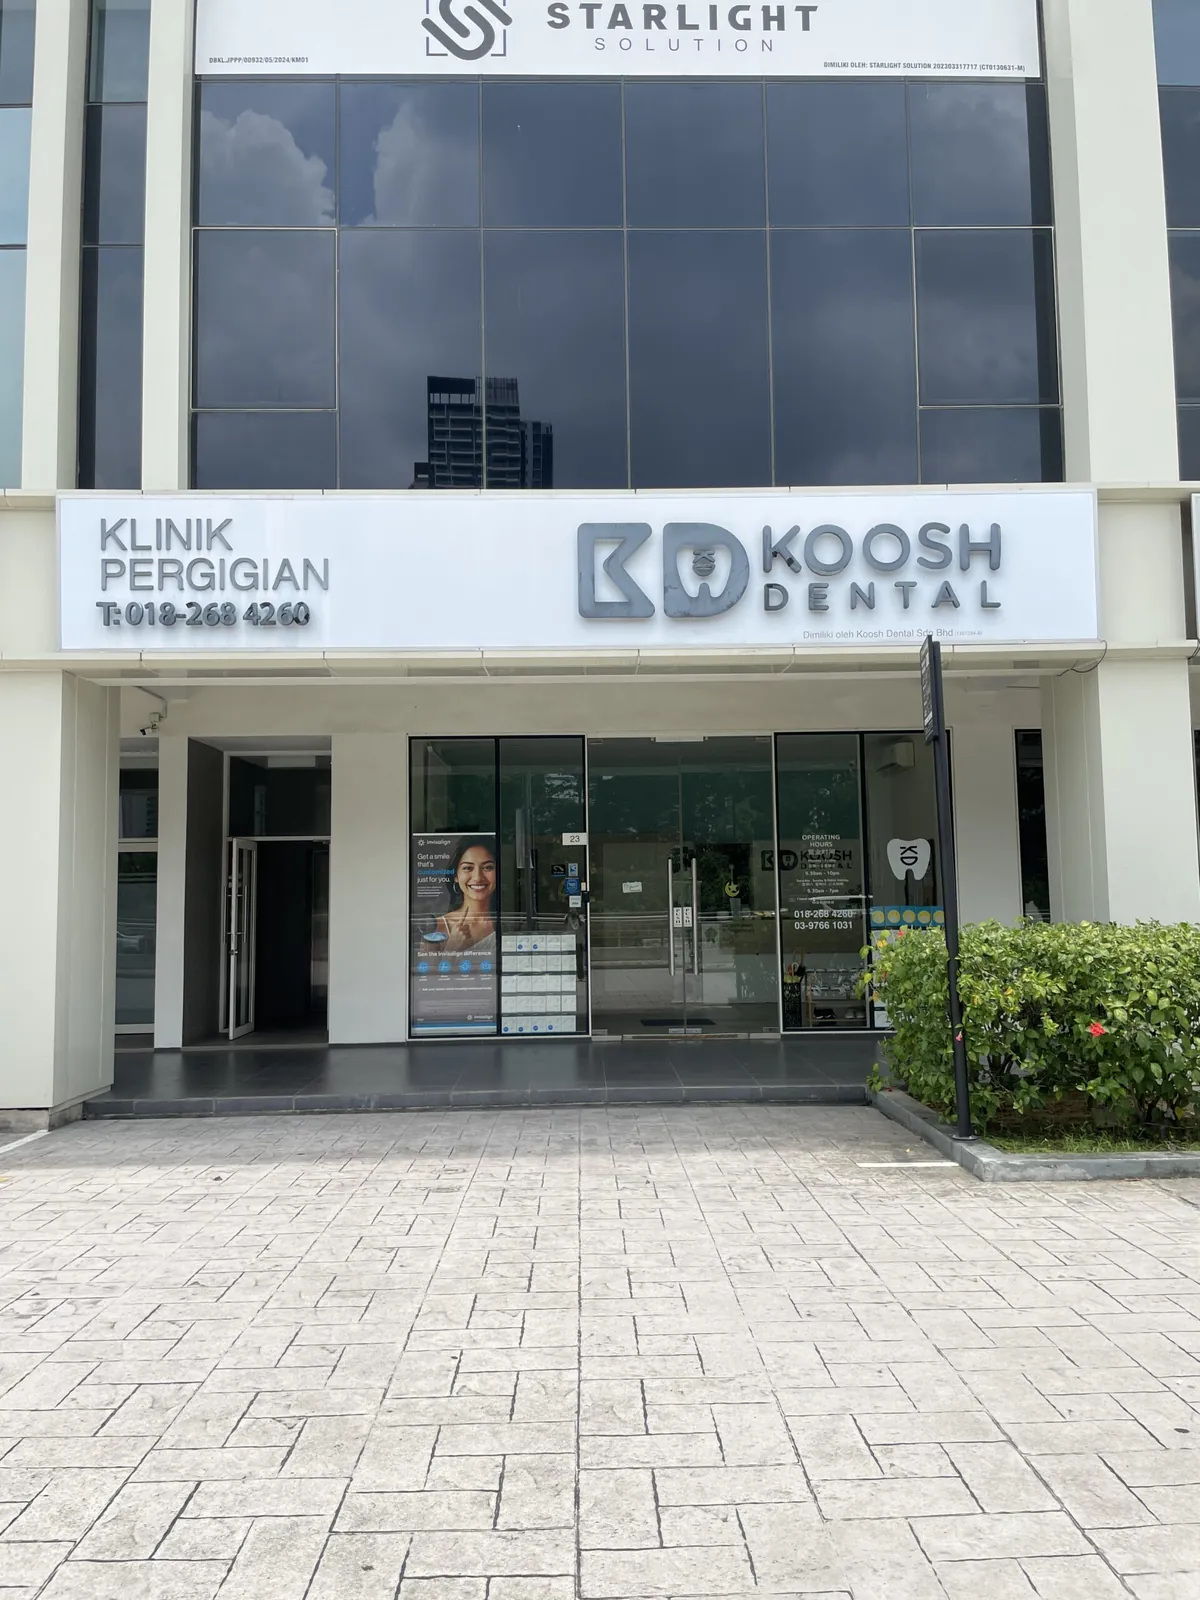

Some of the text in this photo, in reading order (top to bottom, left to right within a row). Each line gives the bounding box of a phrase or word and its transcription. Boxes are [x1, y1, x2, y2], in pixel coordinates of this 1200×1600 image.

[546, 2, 819, 31] STARLIGHT
[594, 37, 773, 52] SOLUTION
[902, 62, 932, 70] SOLUTION
[100, 518, 234, 552] KLINIK
[762, 522, 1002, 577] KOOSH
[101, 557, 329, 592] PERGIGIAN
[763, 580, 1002, 613] DENTAL
[242, 602, 311, 627] 4260
[803, 630, 833, 640] Dimiliki
[835, 630, 854, 639] oleh
[856, 629, 884, 638] Koosh
[886, 628, 914, 638] Dental
[936, 628, 954, 637] Bhd
[569, 834, 581, 843] 23
[417, 876, 429, 884] just
[794, 909, 830, 918] 018-268
[794, 920, 853, 930] 03-9766 1031
